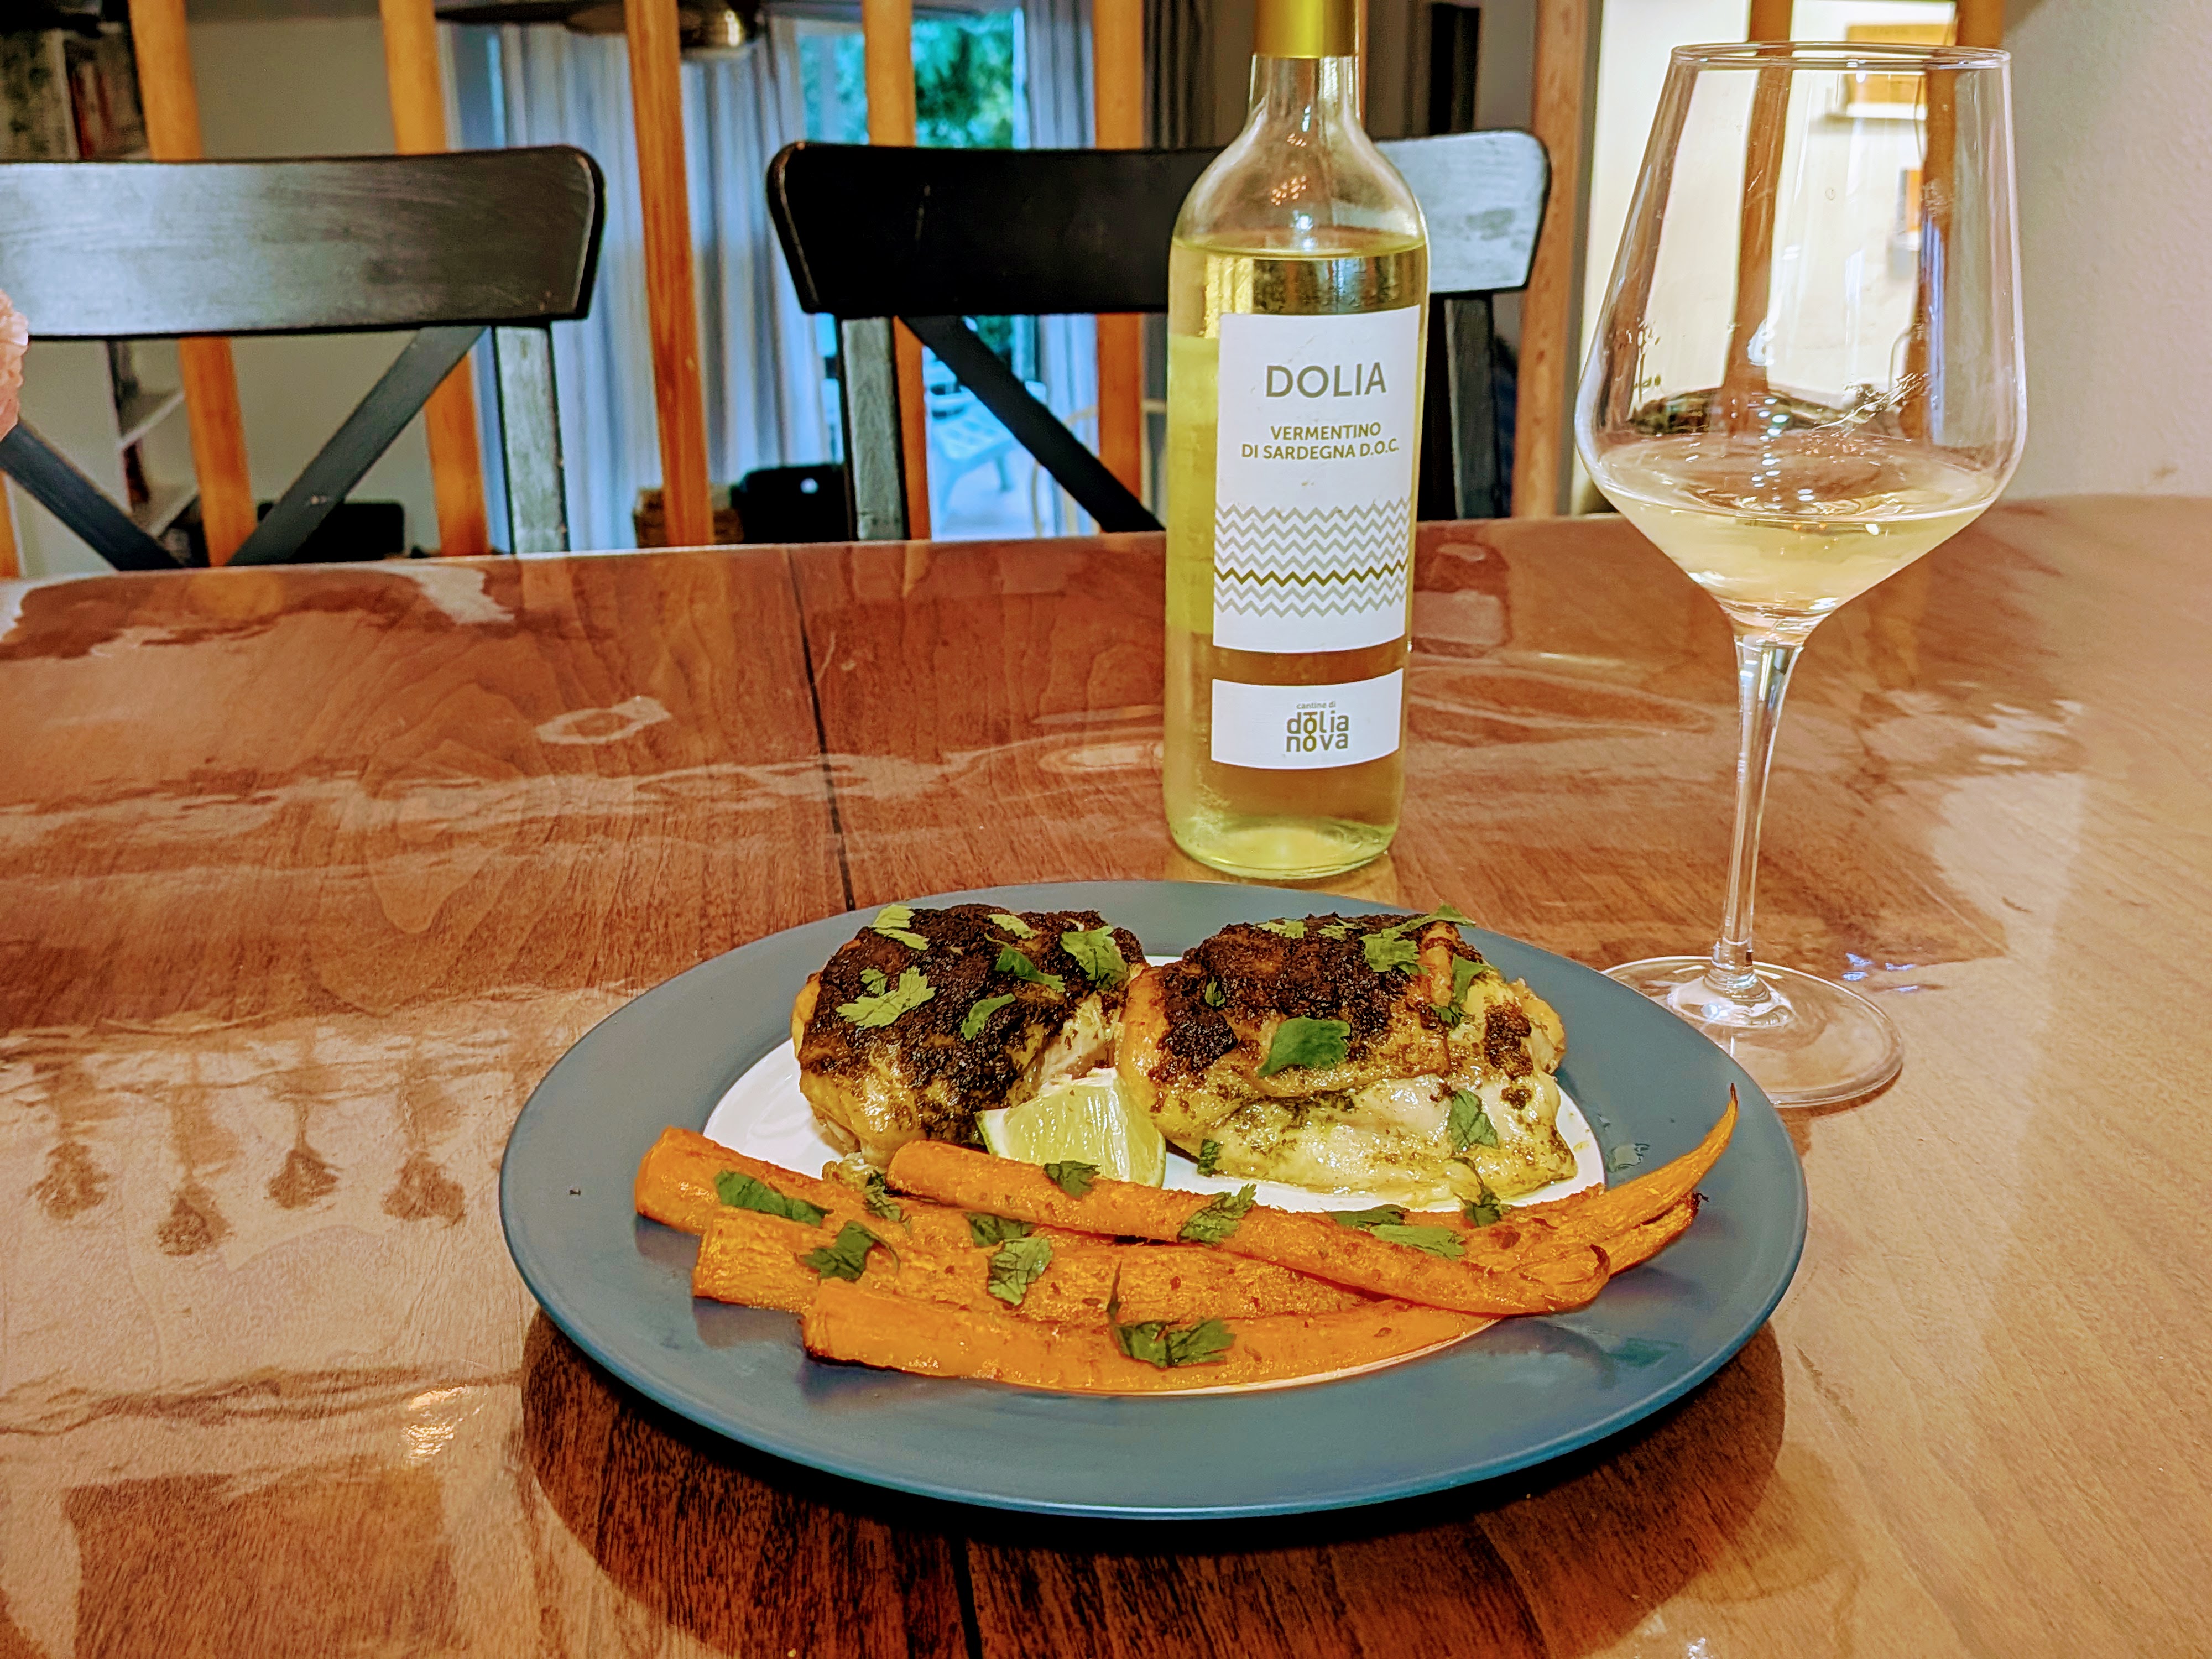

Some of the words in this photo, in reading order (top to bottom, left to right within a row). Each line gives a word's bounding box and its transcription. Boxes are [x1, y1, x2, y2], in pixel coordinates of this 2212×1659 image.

[1266, 362, 1386, 398] DOLIA
[1270, 422, 1381, 440] VERMENTINO
[1241, 444, 1258, 458] DI
[1263, 444, 1356, 460] SARDEGNA
[1286, 733, 1348, 752] nova
